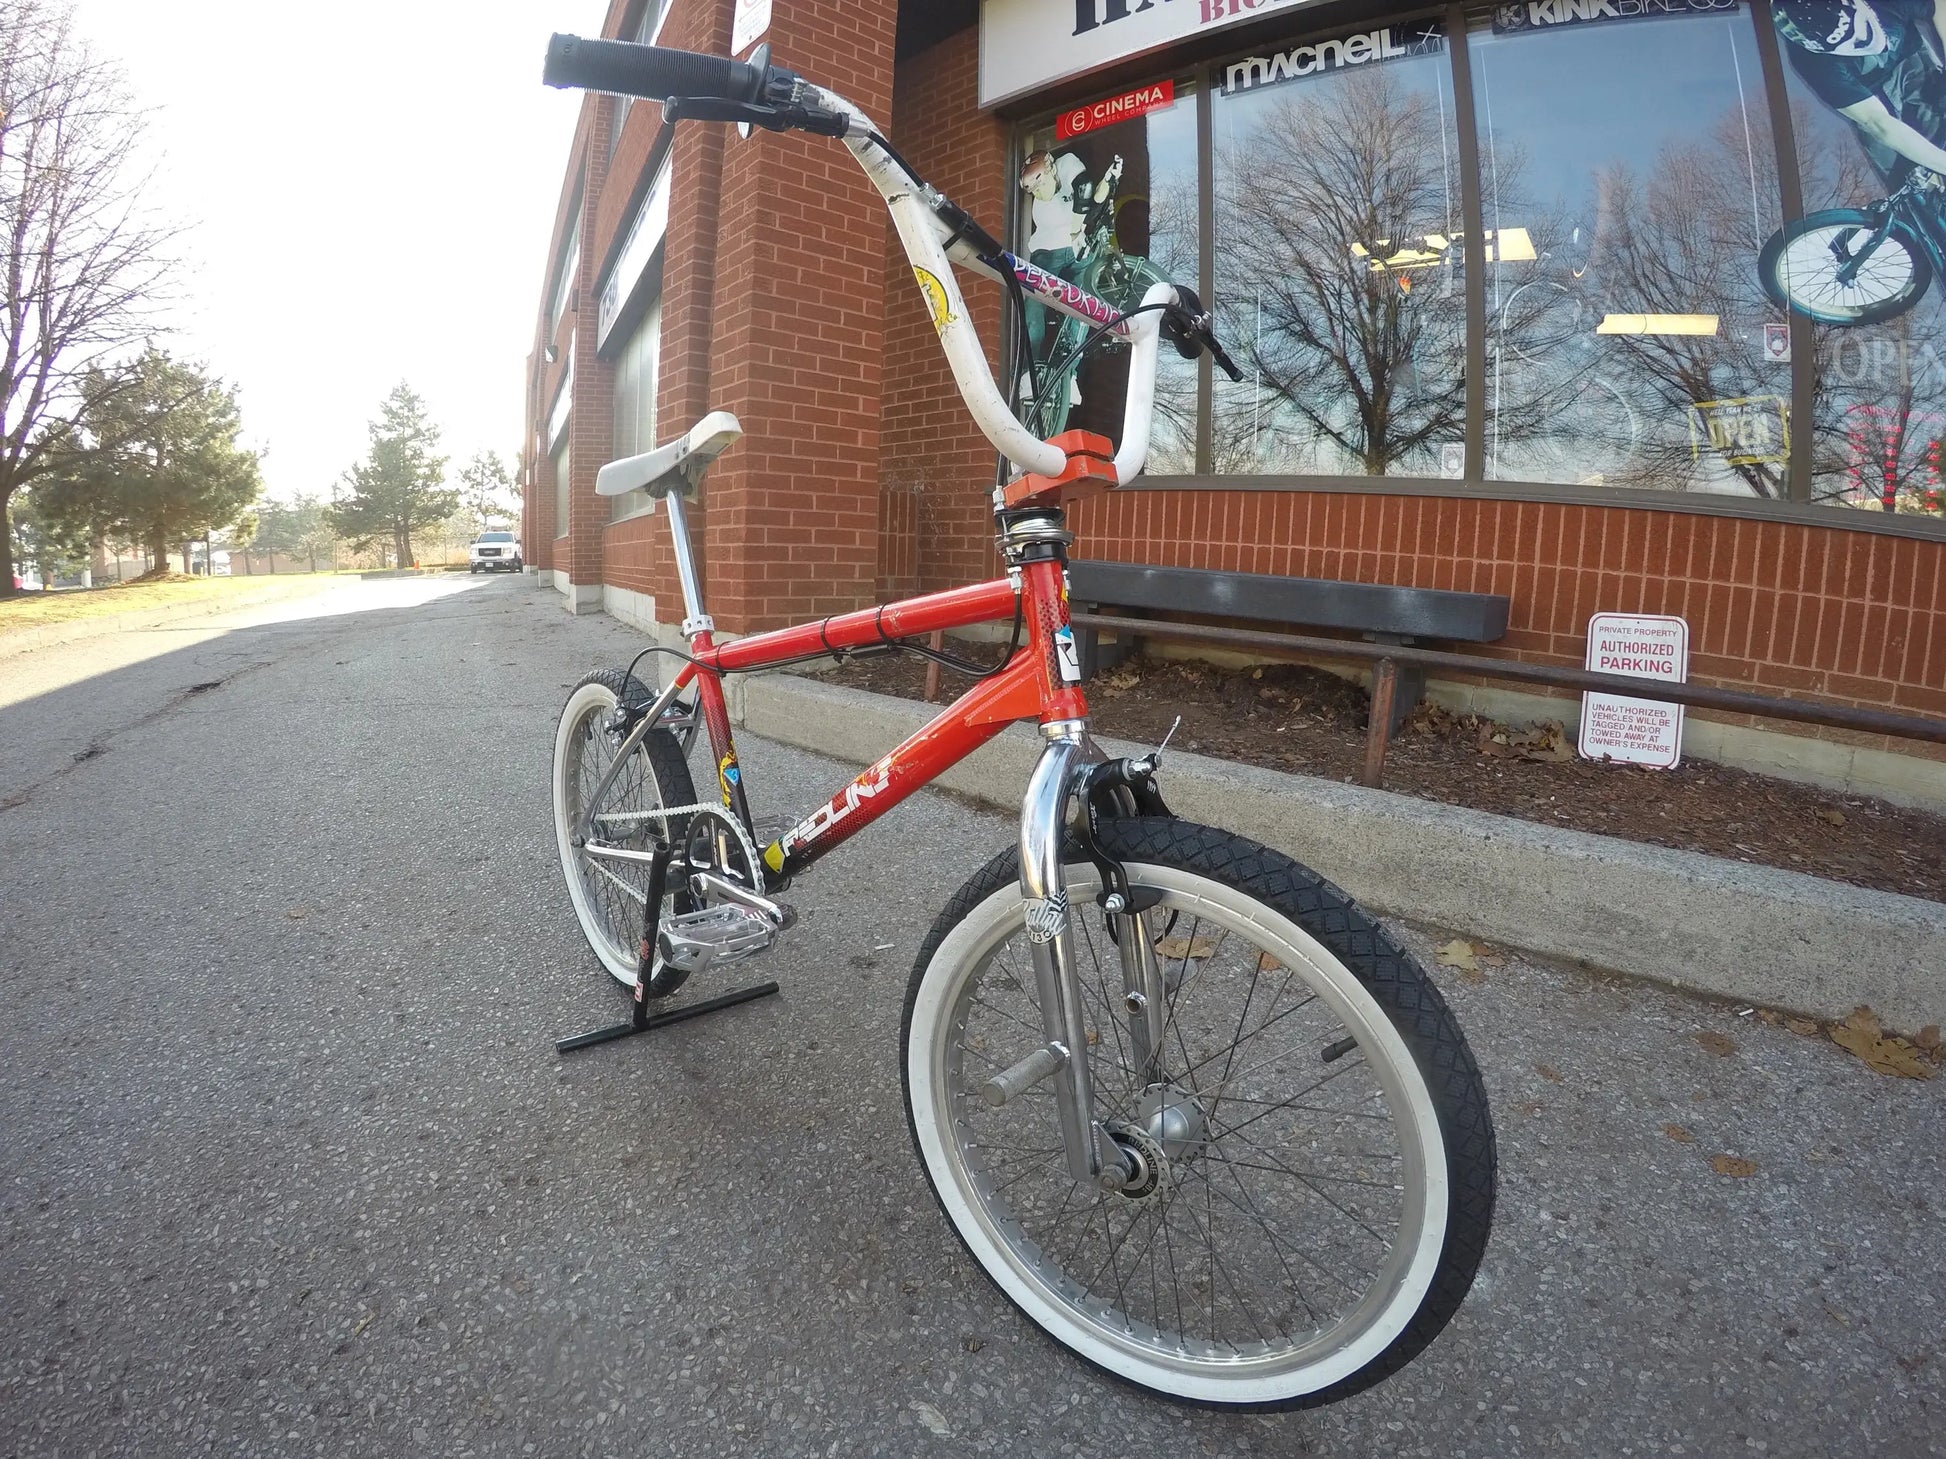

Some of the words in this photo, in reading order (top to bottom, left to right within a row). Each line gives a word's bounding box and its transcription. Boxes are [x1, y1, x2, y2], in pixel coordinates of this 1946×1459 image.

[1529, 0, 1620, 26] KINK
[1093, 86, 1163, 119] CINEMA
[1094, 114, 1121, 126] WHEEL
[1599, 626, 1632, 635] PRIVATE
[1634, 627, 1678, 637] PROPERTY
[1600, 640, 1674, 656] AUTHORIZED
[1600, 656, 1673, 673] PARKING
[1592, 703, 1667, 718] UNAUTHORIZED
[1592, 711, 1633, 723] VEHICLES
[1636, 716, 1657, 726] WILL
[1658, 719, 1671, 727] BE
[1592, 719, 1625, 730] TAGGED
[1627, 725, 1661, 734] AND/OR
[1590, 727, 1621, 738] TOWED
[1624, 732, 1646, 741] AWAY
[1648, 735, 1660, 743] AT
[1589, 736, 1628, 748] OWNER'S
[1630, 741, 1671, 753] EXPENSE
[1128, 1136, 1158, 1175] REDLINE
